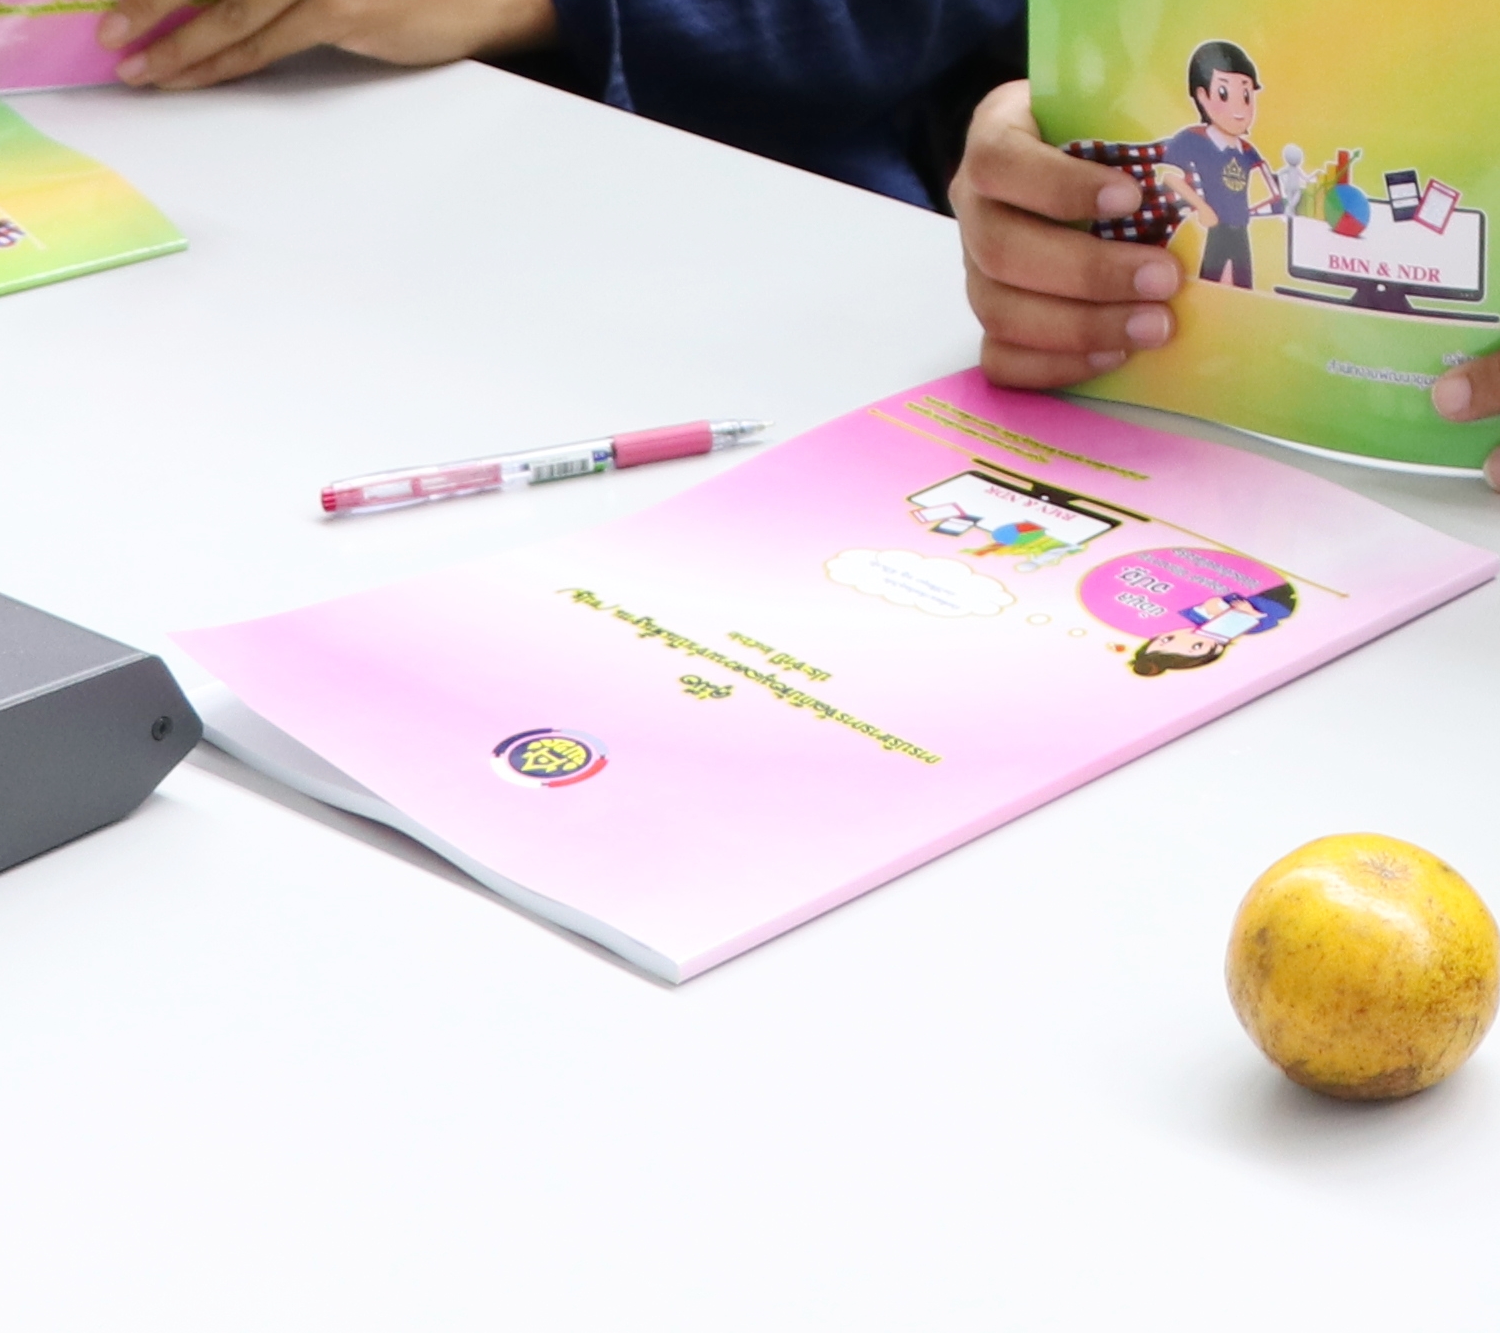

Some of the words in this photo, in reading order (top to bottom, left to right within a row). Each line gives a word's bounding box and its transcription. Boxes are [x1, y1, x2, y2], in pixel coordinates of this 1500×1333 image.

[1328, 254, 1370, 274] BMN
[1376, 261, 1391, 277] &
[1398, 264, 1442, 283] NDR
